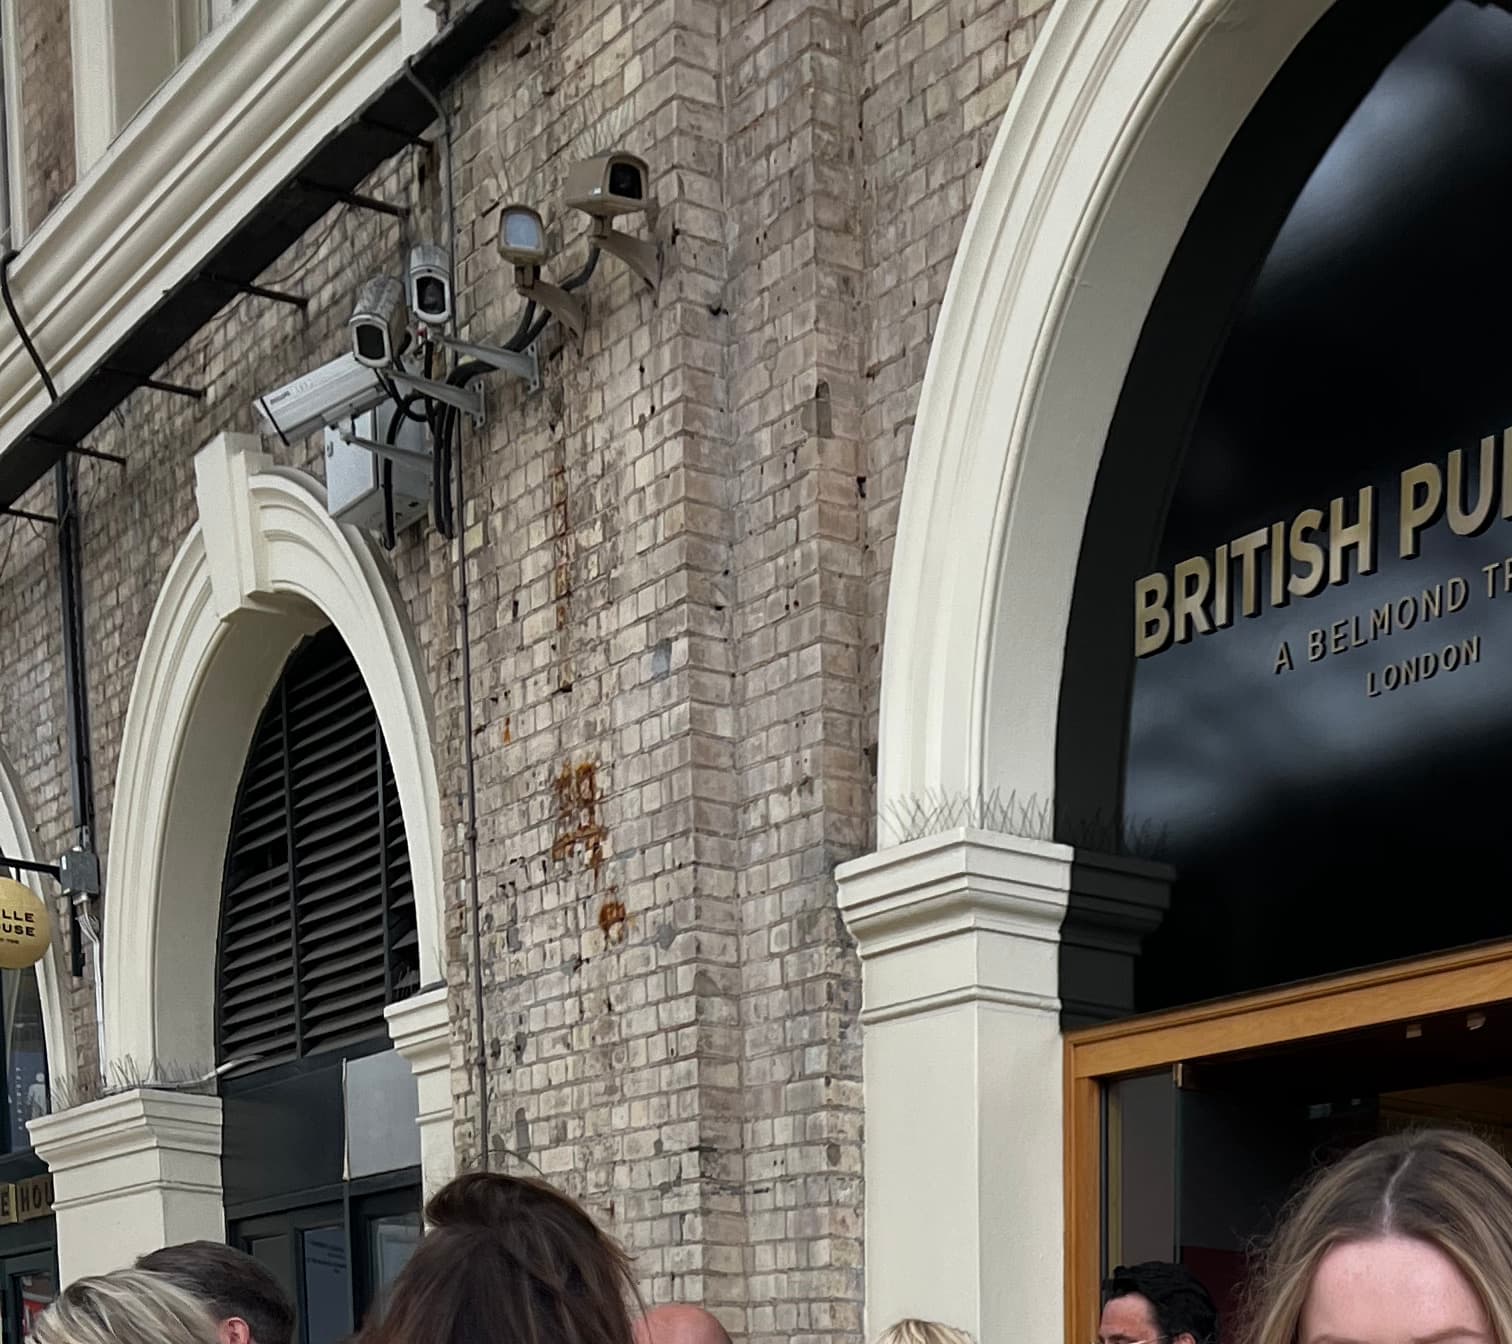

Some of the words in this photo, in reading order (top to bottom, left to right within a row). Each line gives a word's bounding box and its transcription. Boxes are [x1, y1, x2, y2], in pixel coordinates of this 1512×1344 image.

[1135, 485, 1377, 658] BRITISH
[1274, 641, 1294, 675] A
[1308, 576, 1469, 662] BELMOND
[1366, 635, 1481, 697] LONDON
[0, 922, 35, 937] USE
